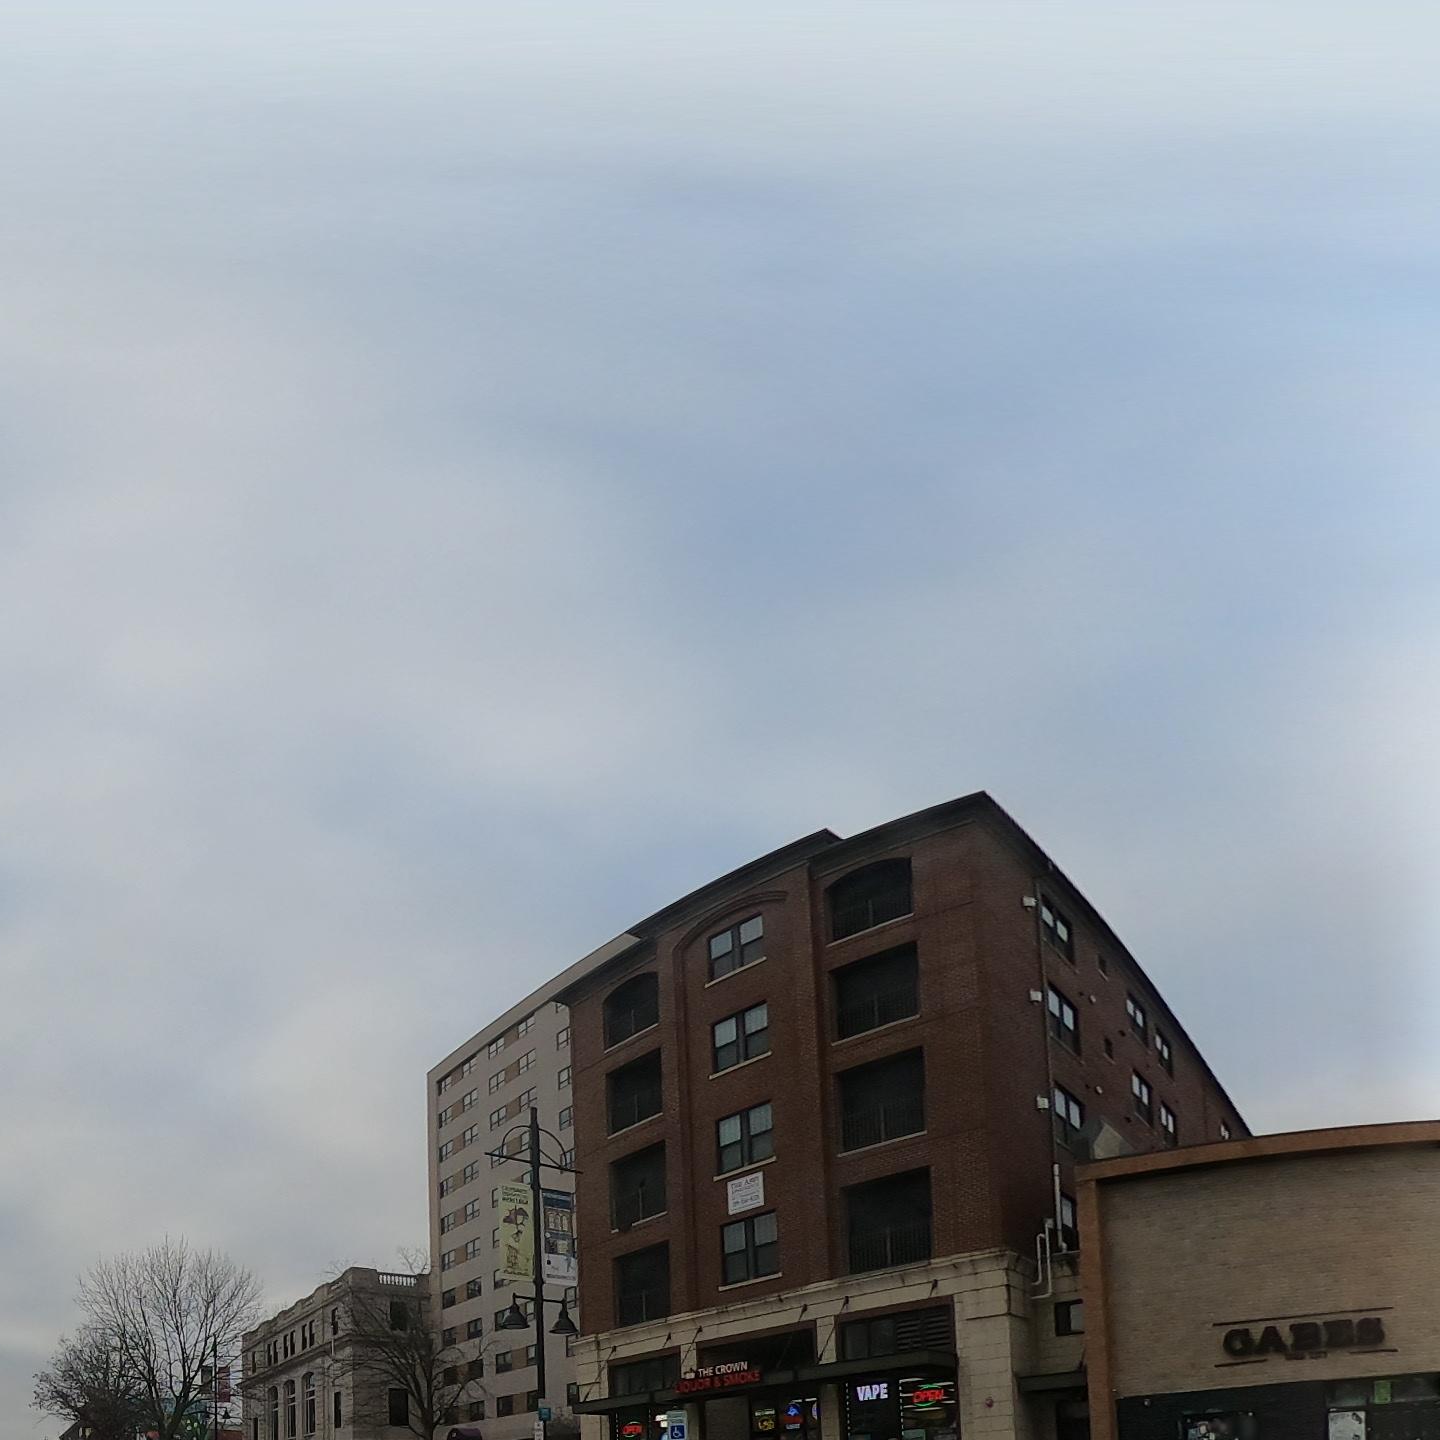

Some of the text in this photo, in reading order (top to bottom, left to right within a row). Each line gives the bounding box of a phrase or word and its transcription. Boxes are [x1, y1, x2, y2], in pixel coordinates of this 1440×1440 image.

[698, 1361, 748, 1377] THE CROWN
[723, 1371, 761, 1386] SMOKE
[856, 1383, 889, 1402] VAPE
[912, 1389, 945, 1404] OPEN
